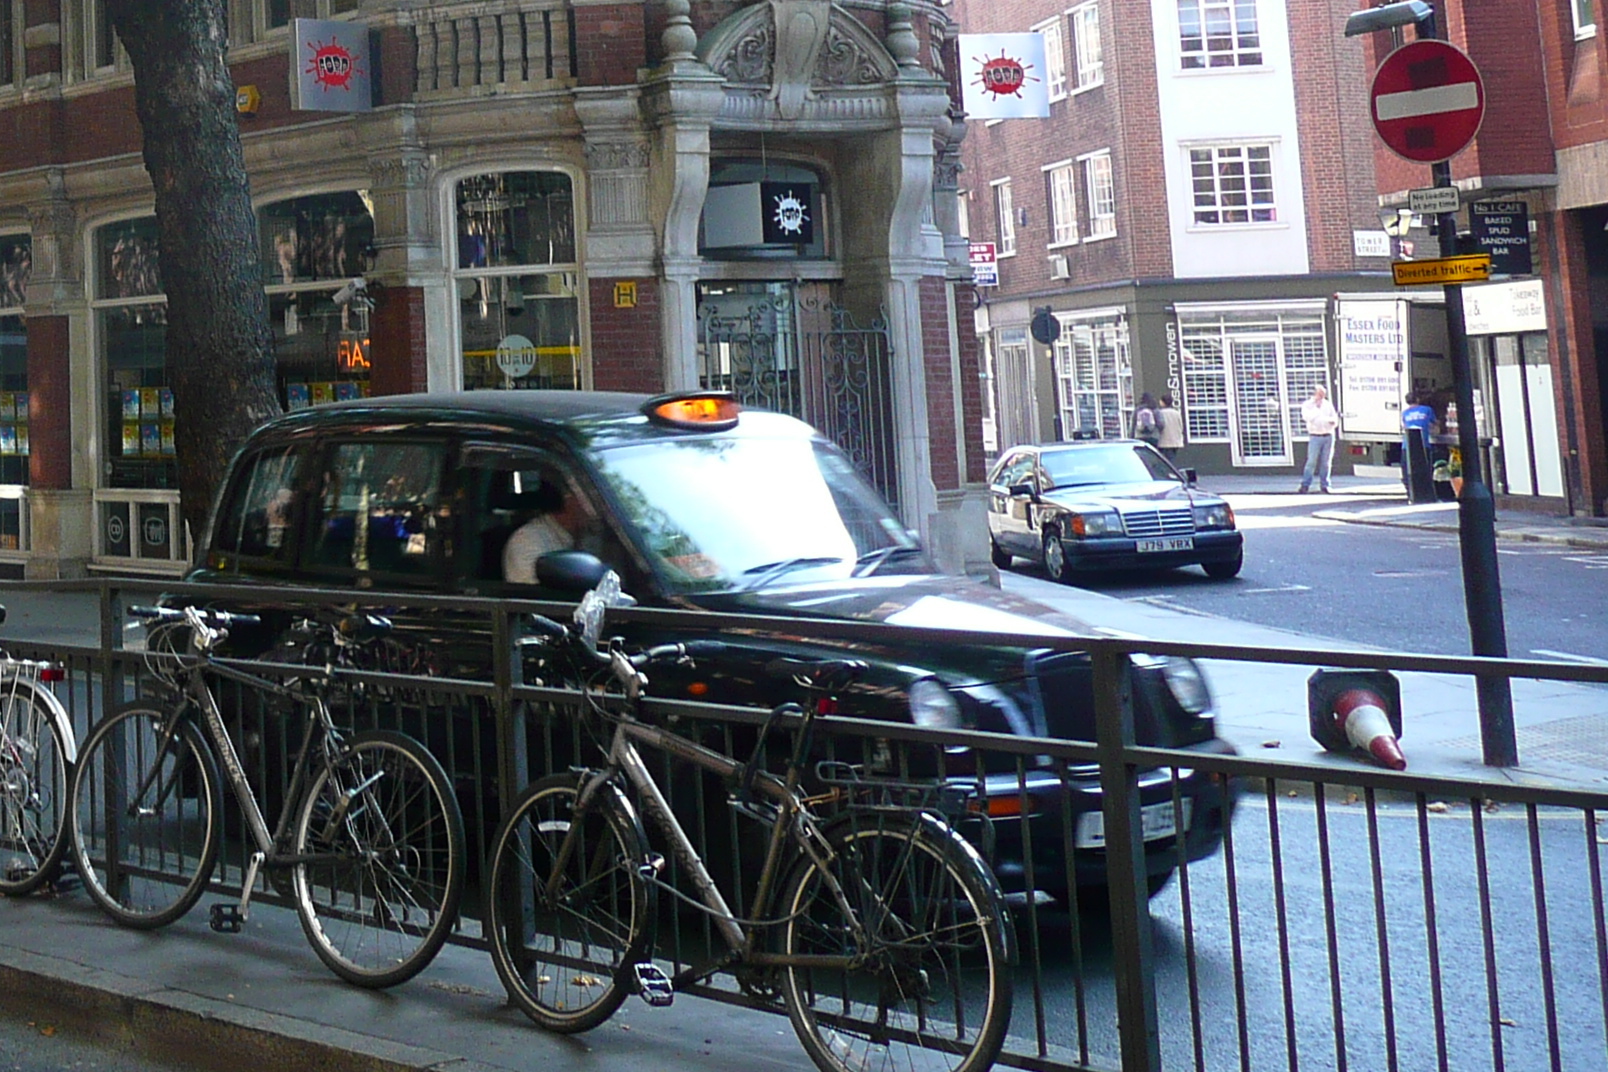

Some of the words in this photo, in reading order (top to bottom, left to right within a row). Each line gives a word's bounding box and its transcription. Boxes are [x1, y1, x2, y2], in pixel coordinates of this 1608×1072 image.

[1425, 191, 1455, 201] loading
[1484, 216, 1513, 225] BAKED
[1488, 227, 1510, 235] SPUD
[1356, 237, 1383, 245] TOWER
[1480, 236, 1528, 245] SANDWICH
[1492, 247, 1510, 255] BAR
[1397, 266, 1438, 279] Diverted
[1441, 263, 1471, 275] traffic
[1345, 332, 1385, 344] MASTERS
[1388, 332, 1404, 344] LTD
[641, 792, 714, 892] ridgeback
